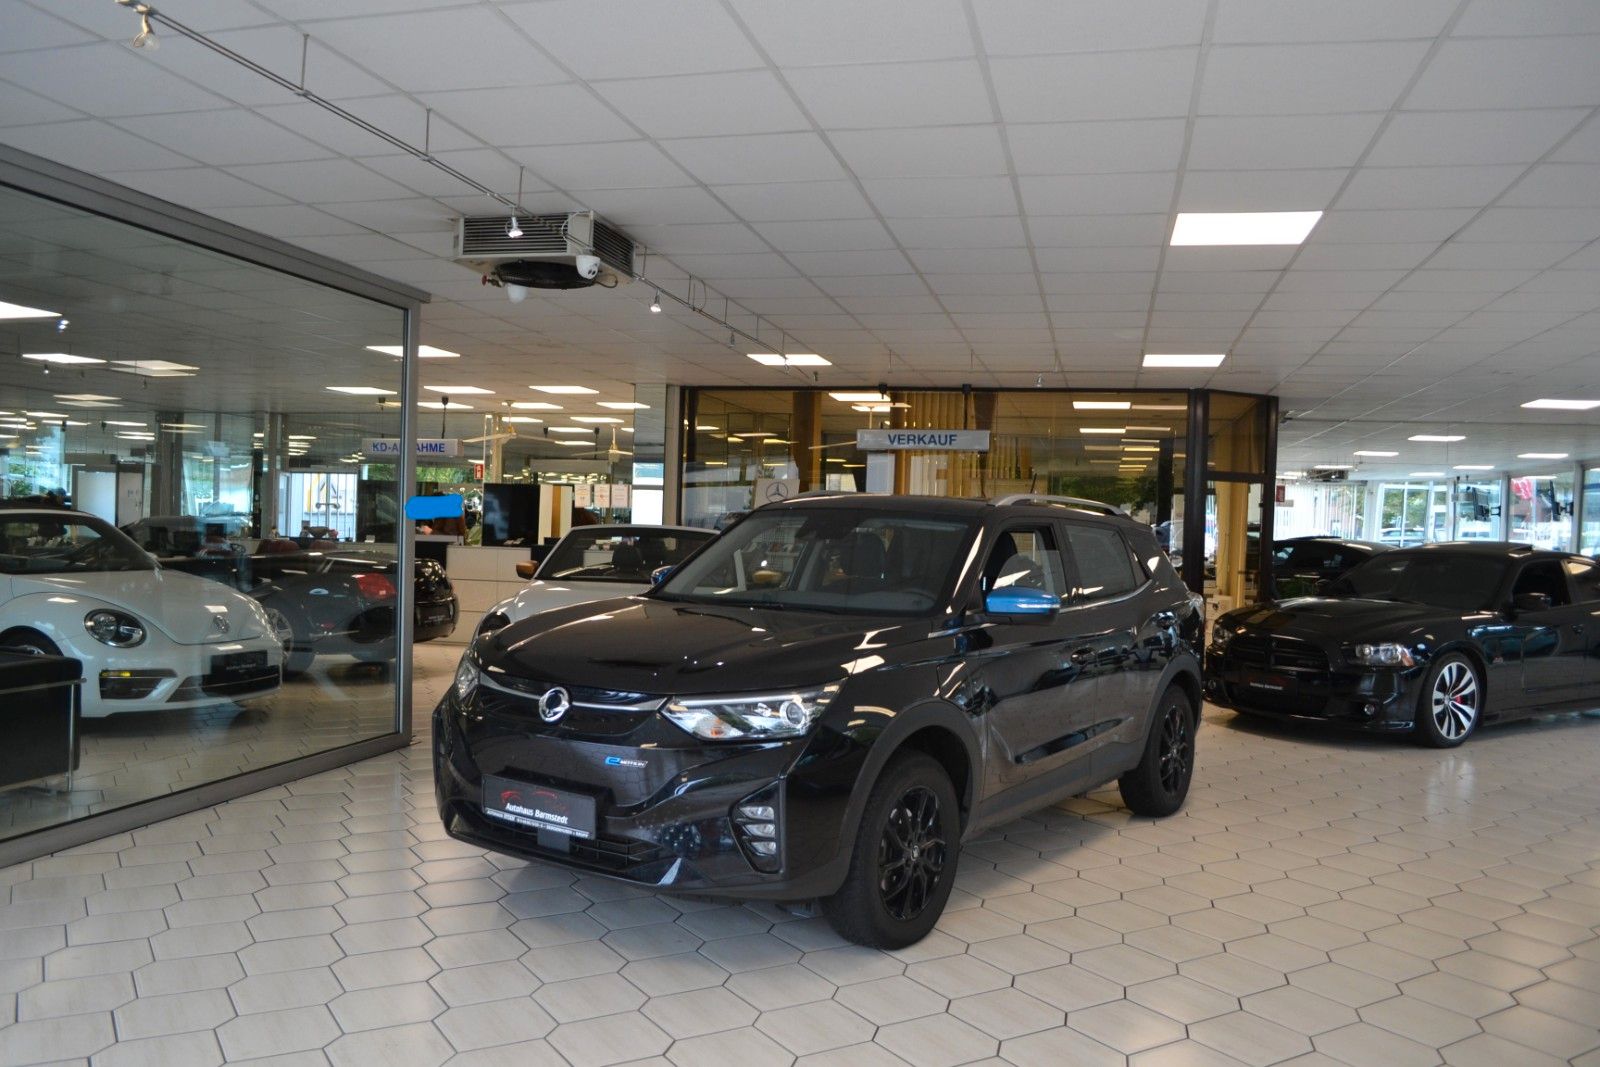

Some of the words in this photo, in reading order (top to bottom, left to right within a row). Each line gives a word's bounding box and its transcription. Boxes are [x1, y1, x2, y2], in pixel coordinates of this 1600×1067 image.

[887, 433, 958, 446] VERKAUF
[505, 802, 534, 817] Autohaus
[534, 808, 569, 825] Barmstedt
